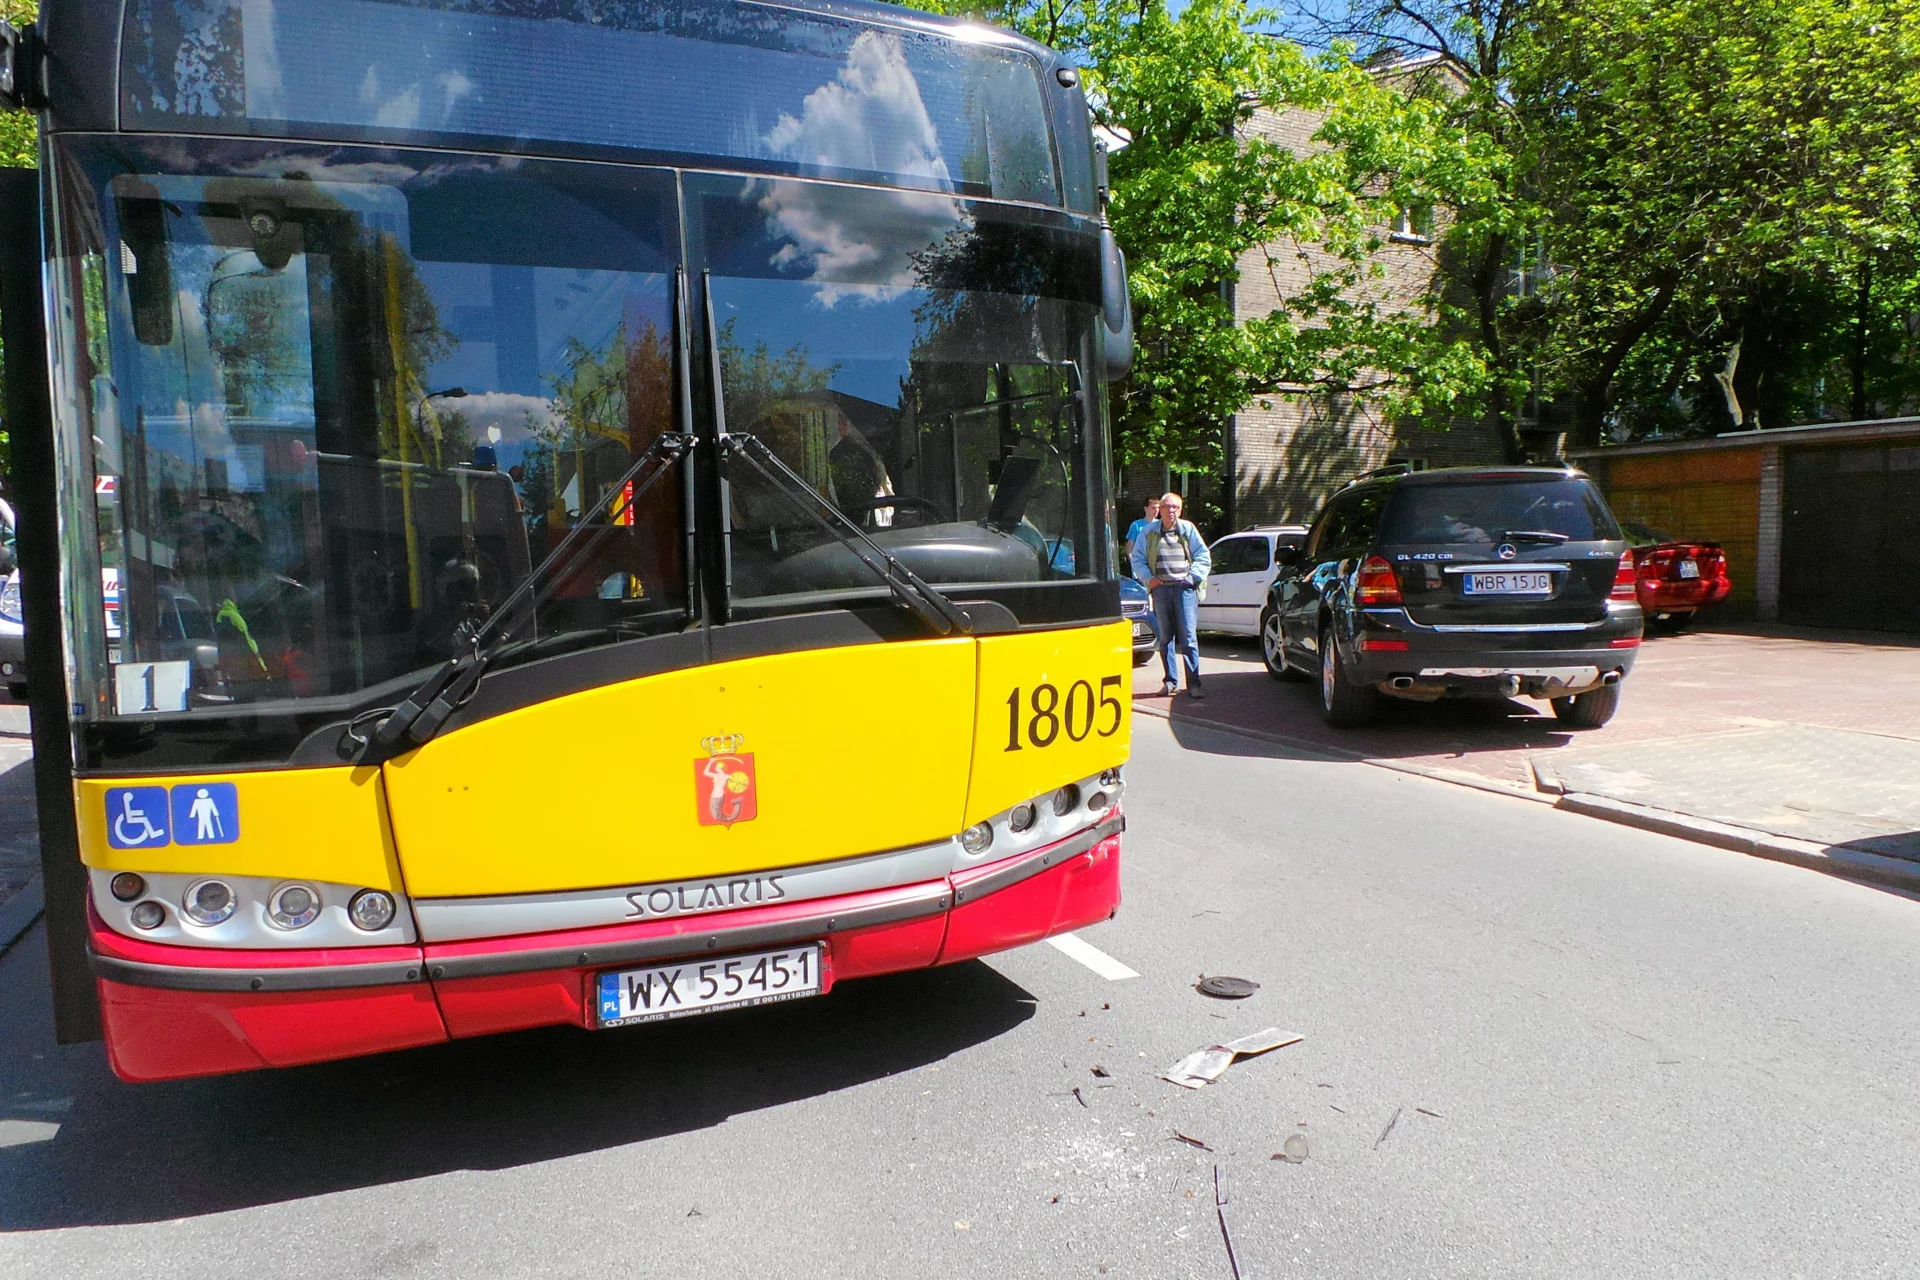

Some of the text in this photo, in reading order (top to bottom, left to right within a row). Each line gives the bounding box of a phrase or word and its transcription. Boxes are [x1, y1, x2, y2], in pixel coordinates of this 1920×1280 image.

[1474, 575, 1547, 590] WBR 15JG
[141, 664, 159, 711] 1
[1004, 674, 1122, 752] 1805
[625, 875, 785, 918] SOLARIS
[627, 951, 809, 1011] WX 55451
[603, 1000, 618, 1013] PL
[625, 1013, 665, 1025] SOLARIS
[762, 989, 816, 1003] 061/8118300
